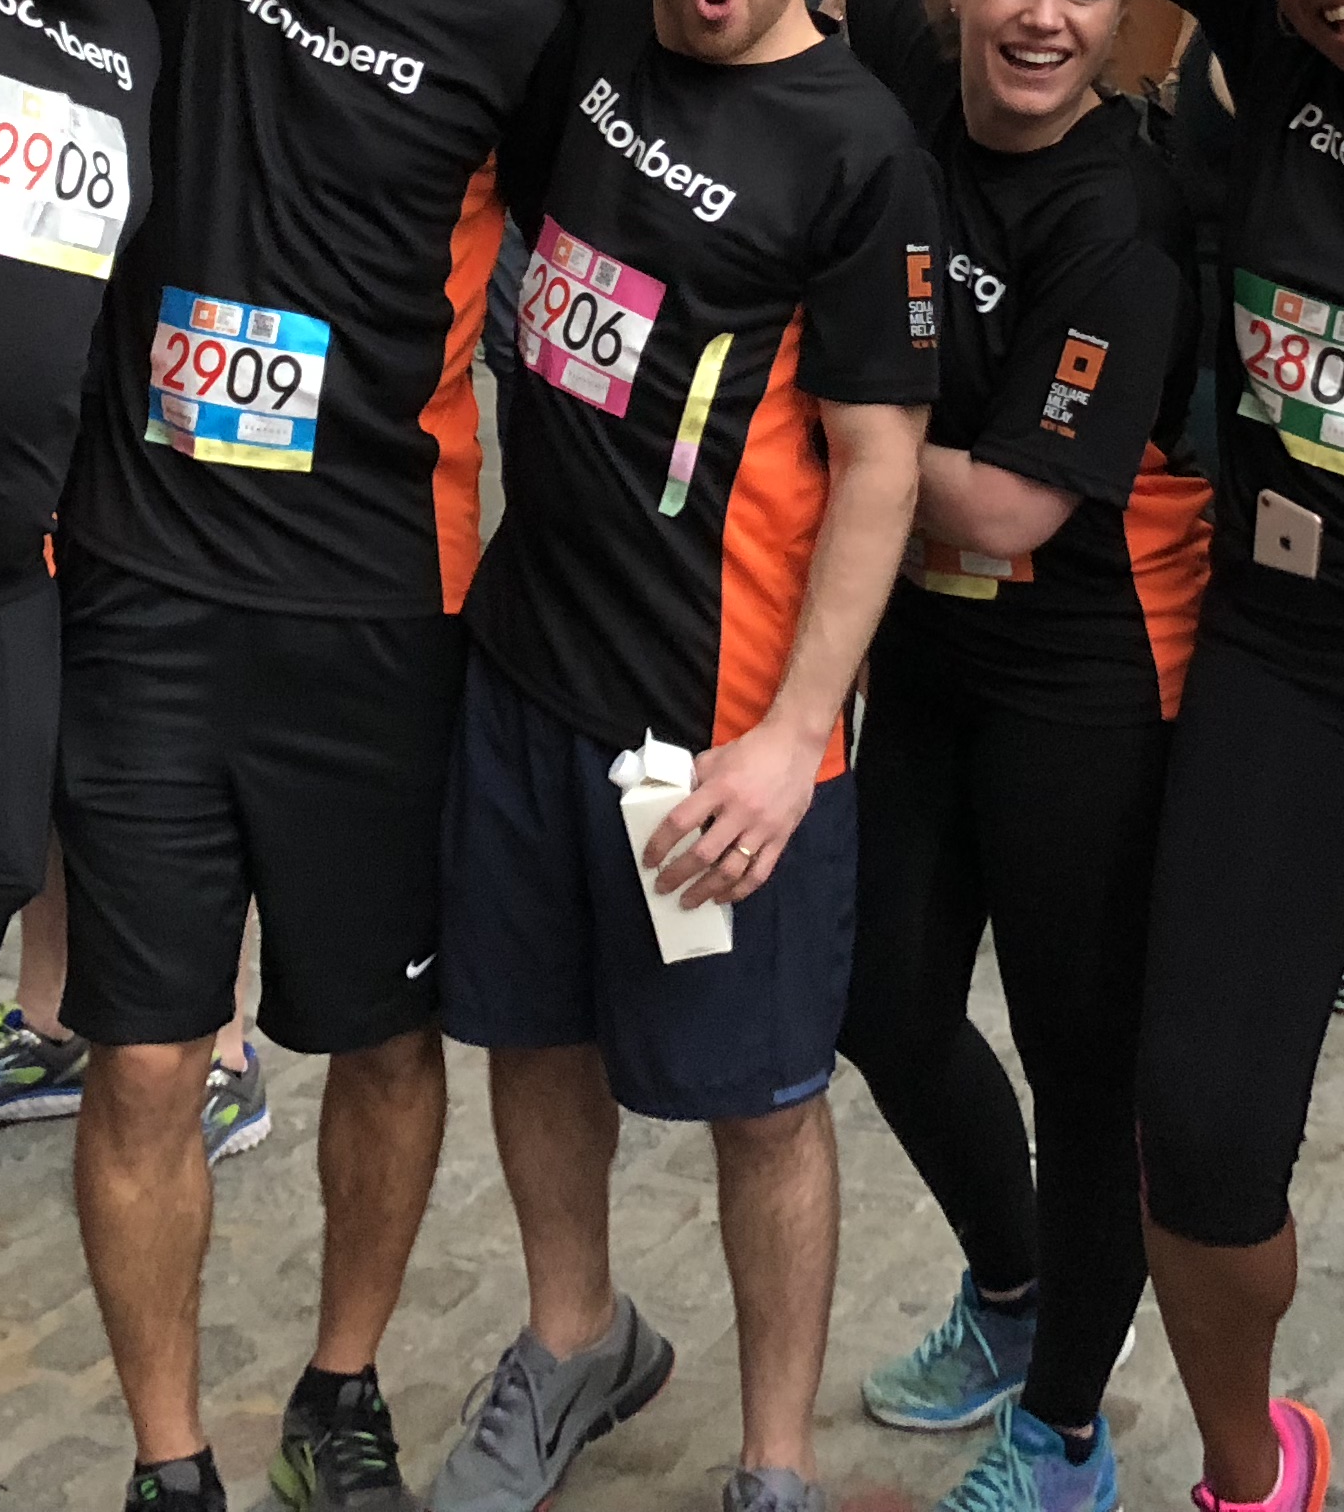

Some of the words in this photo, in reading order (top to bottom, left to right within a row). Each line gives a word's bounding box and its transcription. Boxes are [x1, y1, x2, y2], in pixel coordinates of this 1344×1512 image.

[522, 263, 626, 367] 2906
[162, 332, 303, 411] 2909
[1050, 382, 1091, 406] SQUARE
